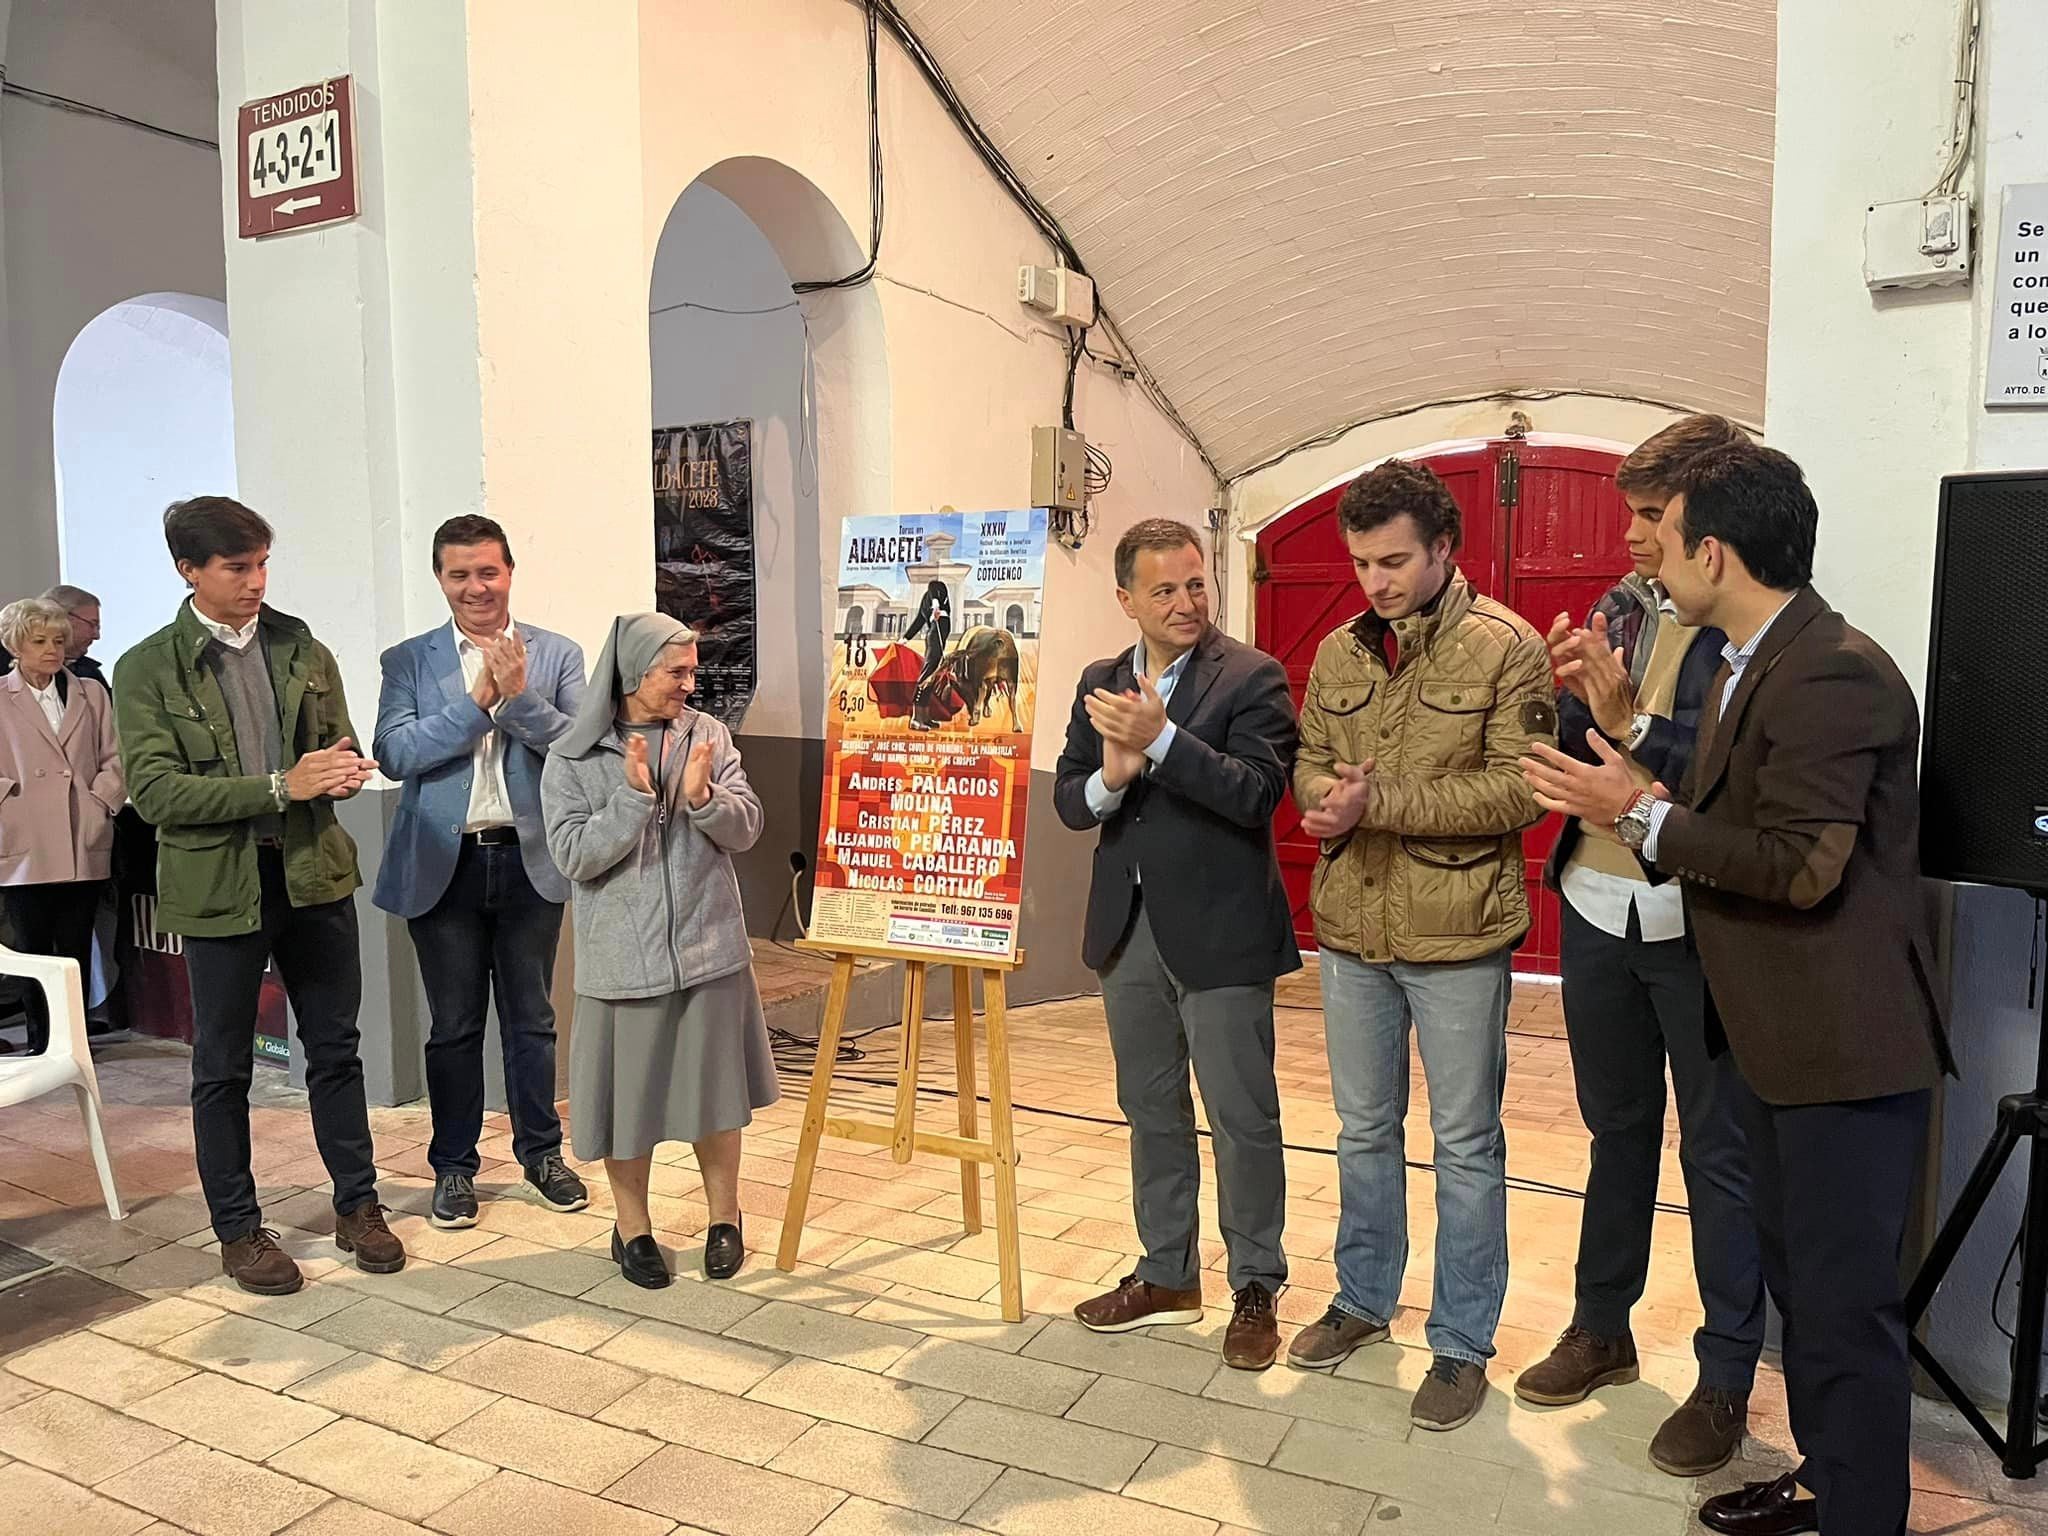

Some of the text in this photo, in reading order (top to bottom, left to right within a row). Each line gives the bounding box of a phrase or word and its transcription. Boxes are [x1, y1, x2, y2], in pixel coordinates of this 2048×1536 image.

[252, 85, 335, 126] TENDIDOS
[253, 118, 337, 189] 4-3-2-1
[2017, 221, 2045, 238] Se
[2014, 250, 2040, 263] un
[2010, 301, 2048, 317] que
[2008, 324, 2047, 340] a lo
[2004, 386, 2046, 395] AYTO. DE
[980, 521, 1007, 537] XXXIV
[848, 536, 924, 564] ALBACETE
[976, 566, 1022, 581] COTOLENGO
[843, 633, 867, 668] 18
[839, 690, 865, 714] 6,30
[848, 771, 999, 797] ANDRÉS PALACIOS
[890, 793, 953, 814] MOLINA
[858, 810, 985, 836] CRISTIAN PÉREZ
[824, 826, 900, 850] ALEJANDRO
[837, 847, 1000, 877] MANUEL CABALLERO
[913, 874, 985, 899] CORTIJO
[960, 905, 976, 917] 967
[978, 907, 993, 918] 135
[995, 908, 1013, 921] 696
